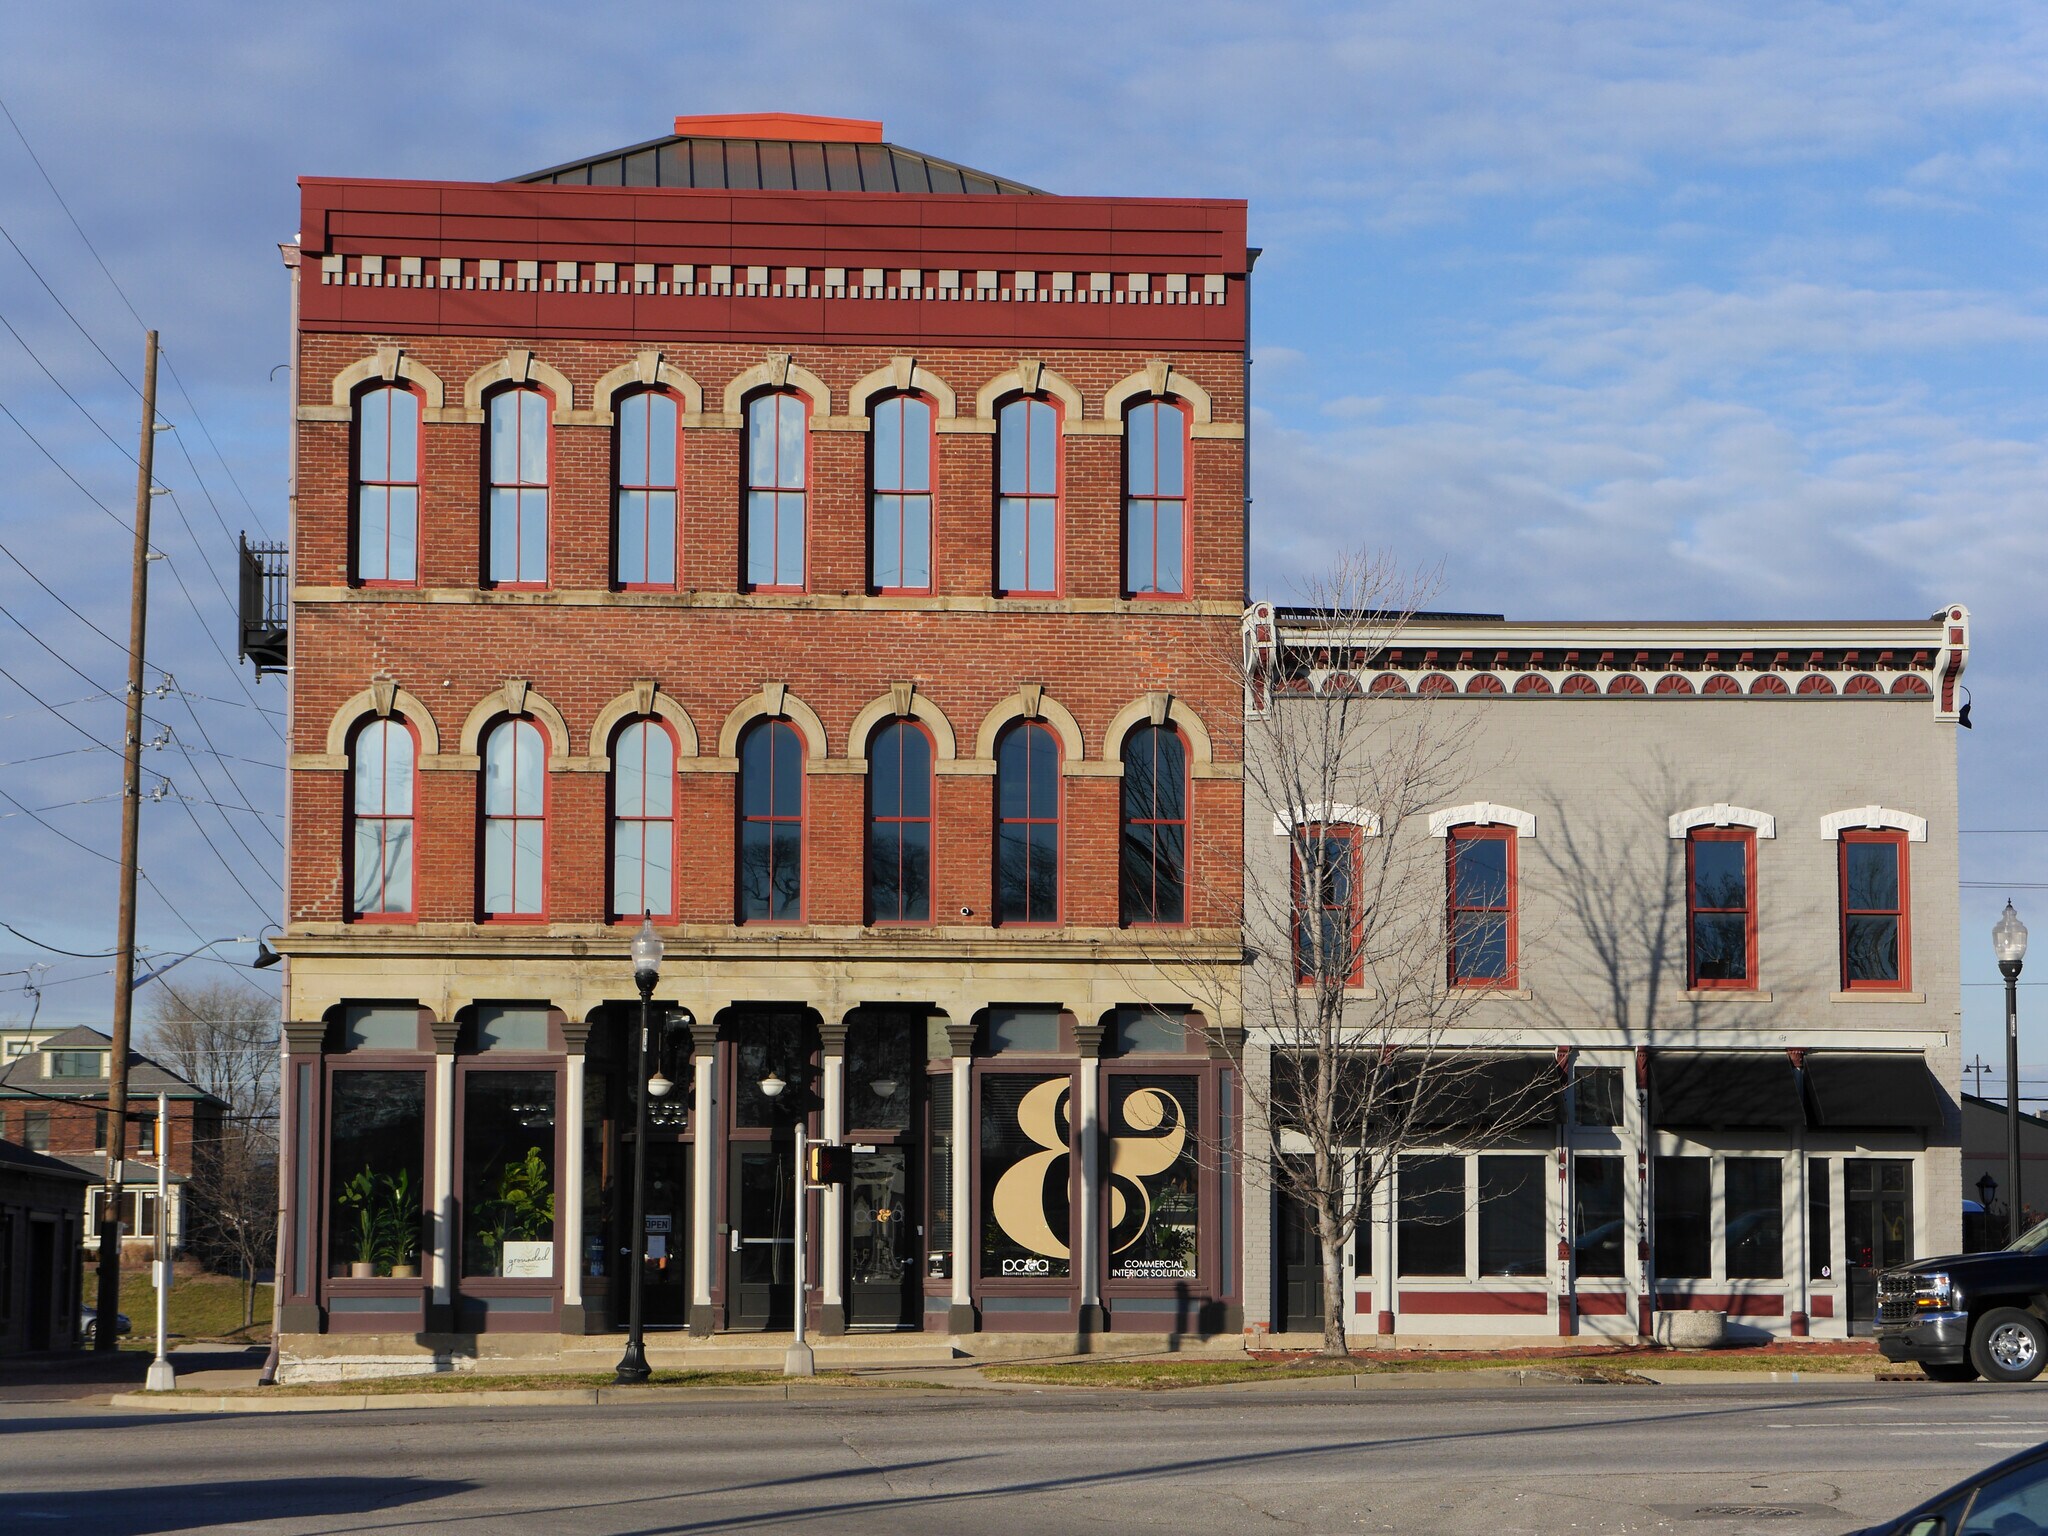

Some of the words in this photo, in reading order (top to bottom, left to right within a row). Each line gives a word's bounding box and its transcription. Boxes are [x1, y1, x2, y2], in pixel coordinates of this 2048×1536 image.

[506, 1247, 550, 1274] grounded
[1002, 1258, 1049, 1276] pc&a
[1124, 1259, 1184, 1269] COMMERCIAL
[1112, 1269, 1149, 1278] INTERIOR
[1150, 1269, 1196, 1278] SOLUTIONS
